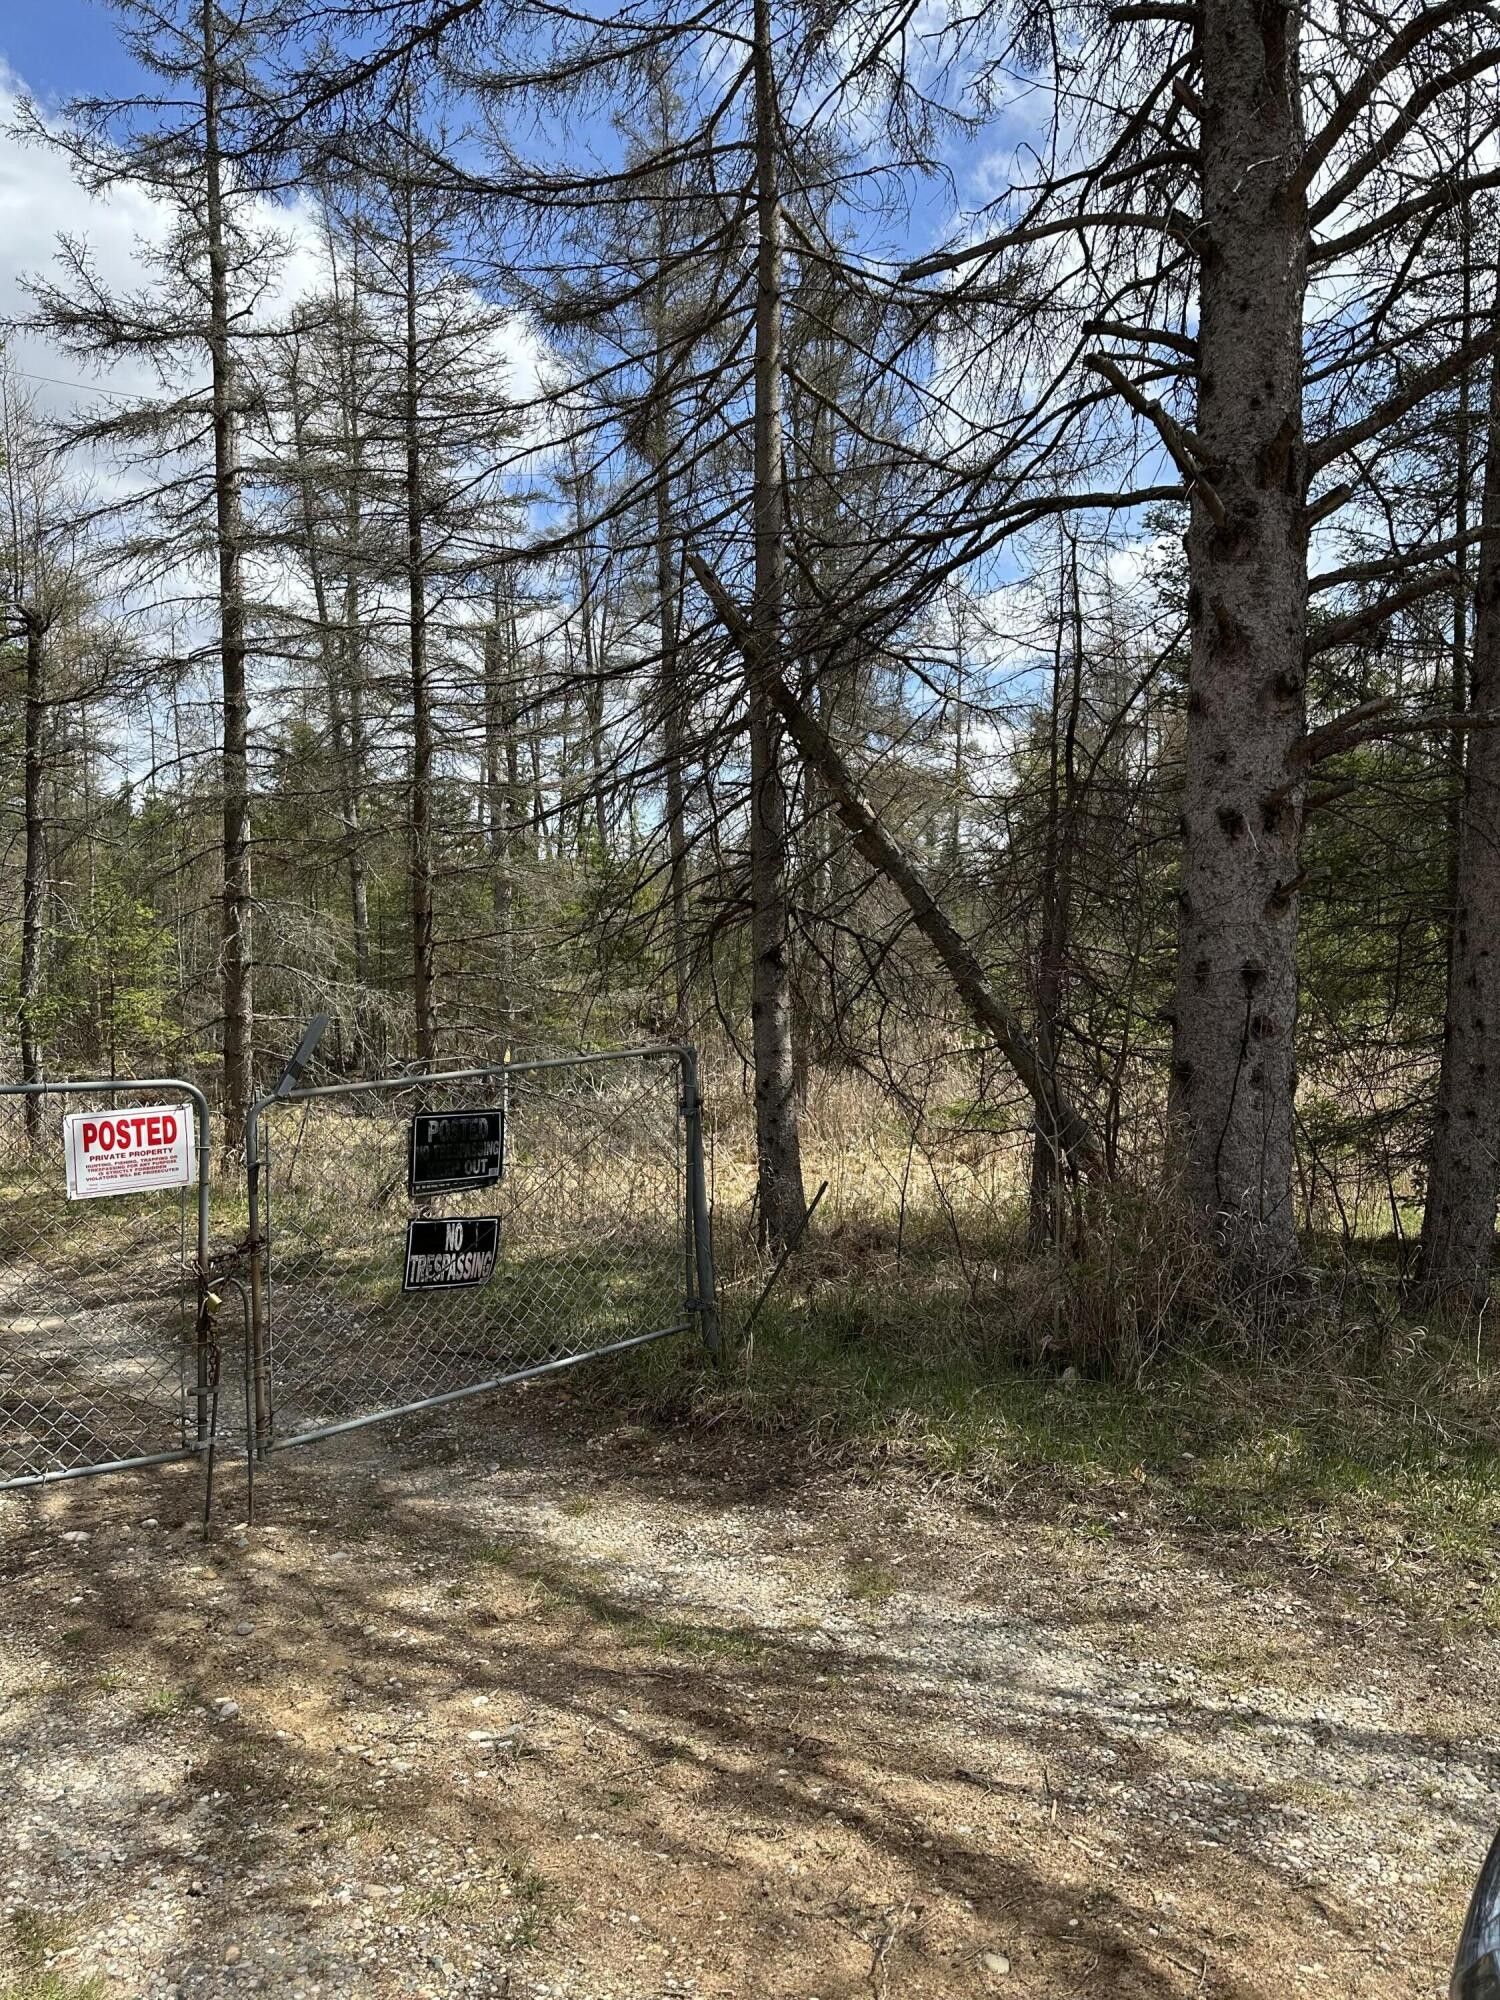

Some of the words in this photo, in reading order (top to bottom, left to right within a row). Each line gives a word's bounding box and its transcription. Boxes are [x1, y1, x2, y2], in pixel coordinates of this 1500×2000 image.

[82, 1115, 177, 1153] POSTED
[428, 1118, 488, 1143] POSTED
[90, 1153, 126, 1162] PRIVATE
[129, 1148, 173, 1159] PROPERTY
[86, 1174, 118, 1182] VIOLATORS
[143, 1167, 179, 1175] PROSECUTED
[88, 1165, 125, 1173] TRESPASSING
[464, 1158, 489, 1175] OUT
[445, 1222, 464, 1251] NO
[410, 1251, 493, 1283] TRESPASSING
